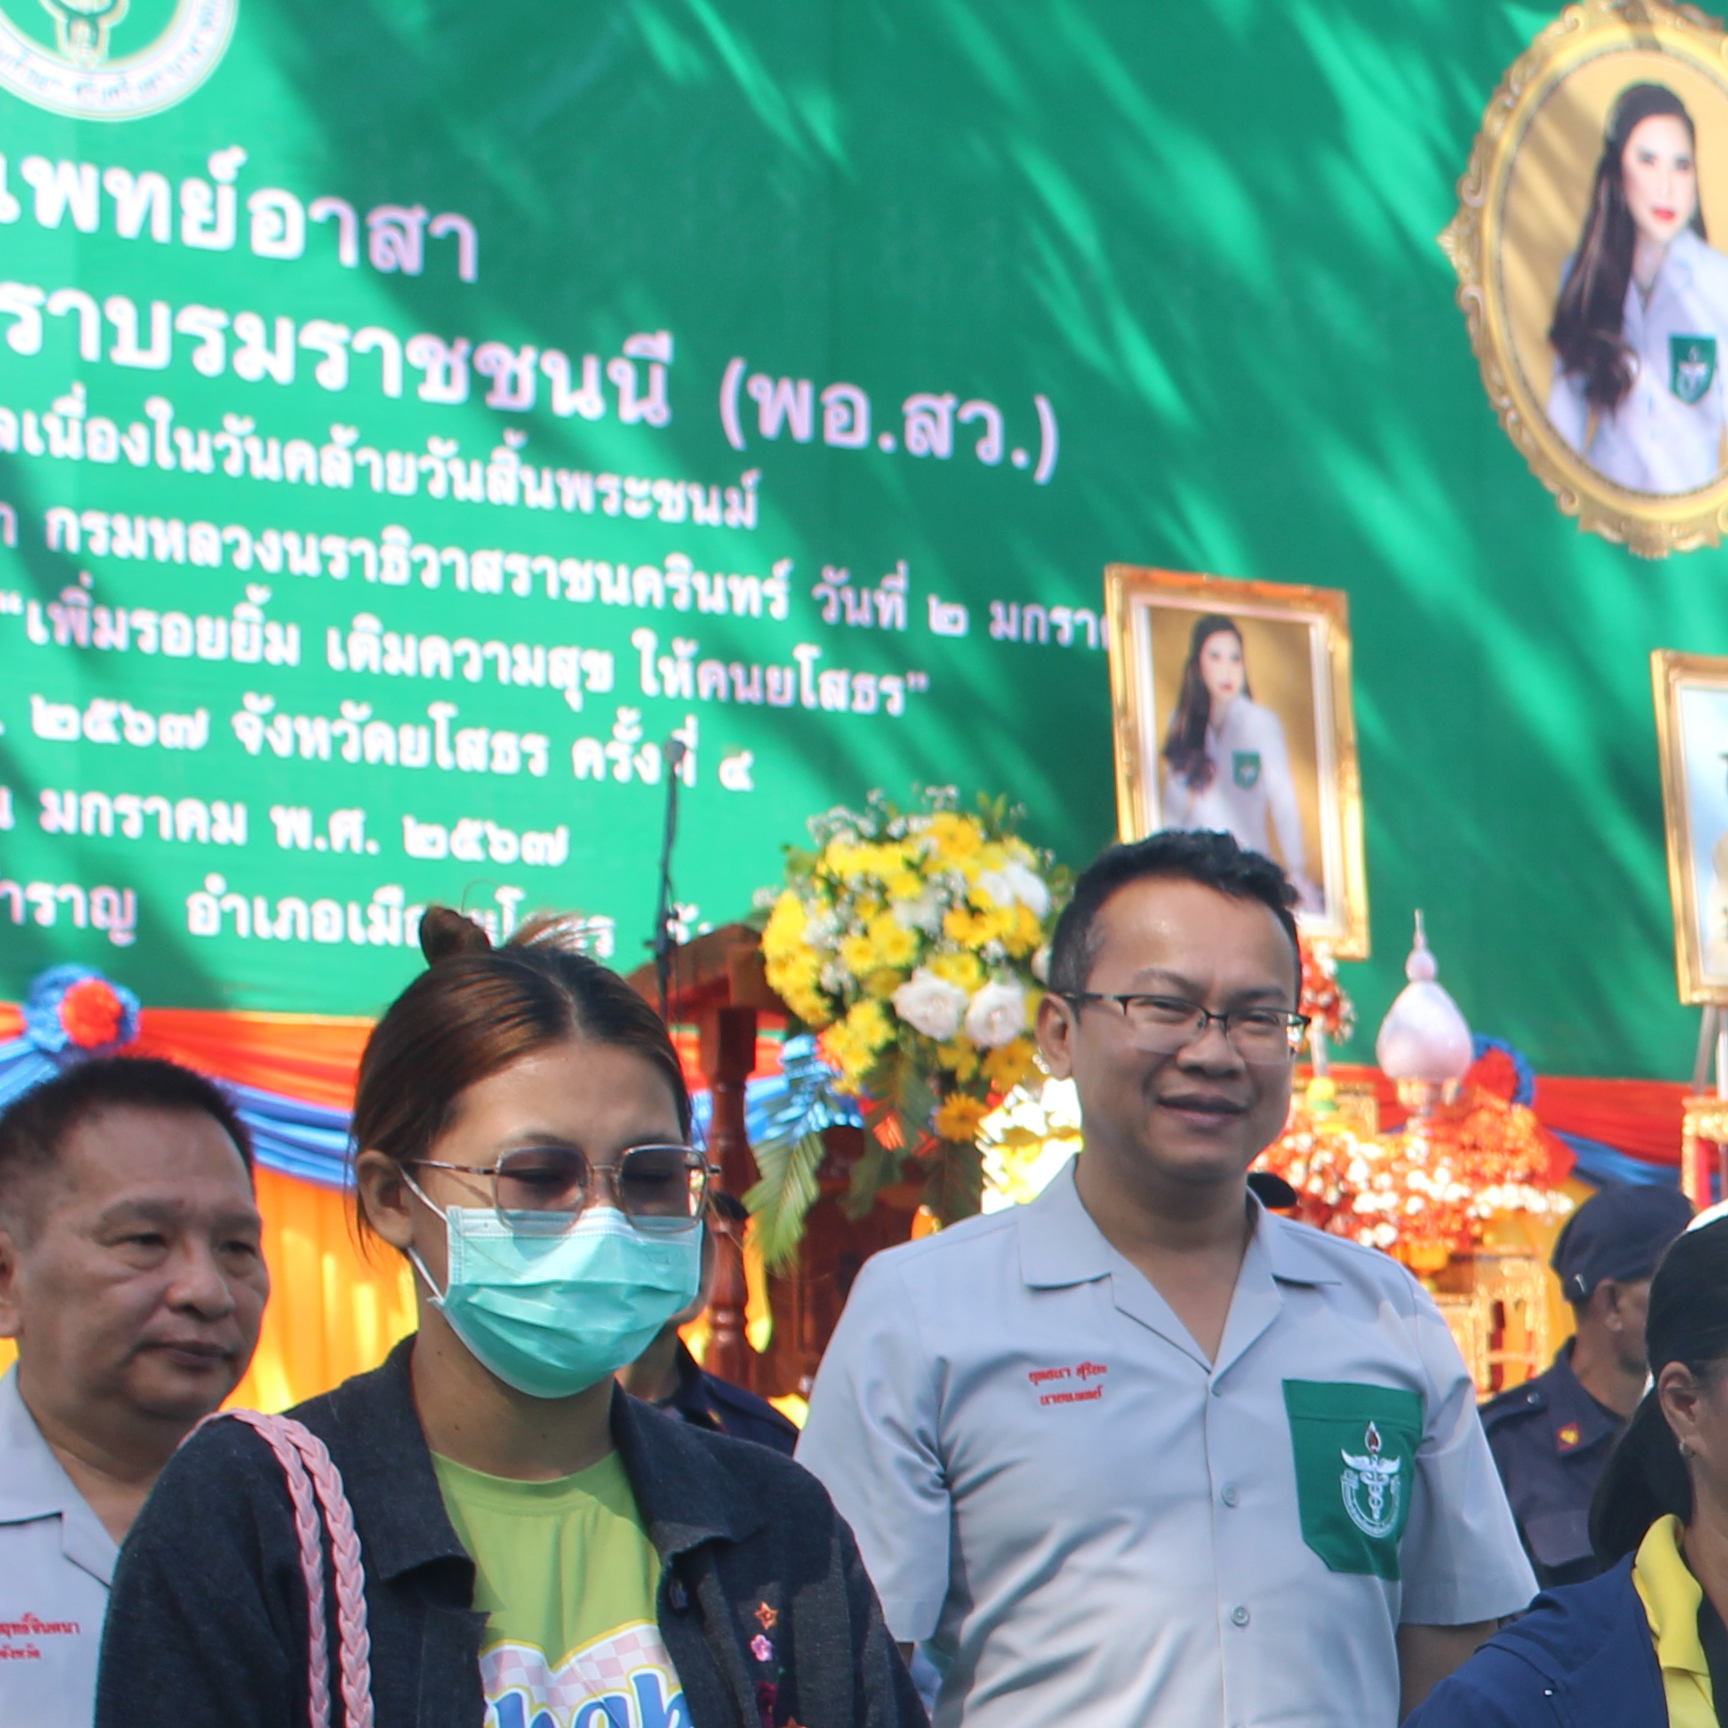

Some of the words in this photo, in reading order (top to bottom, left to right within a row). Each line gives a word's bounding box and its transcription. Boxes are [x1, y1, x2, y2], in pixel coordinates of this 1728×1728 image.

[719, 357, 1059, 484] (พอ.สว.)
[45, 506, 793, 622] กรมหลวงนราธิวาสราชนครินทร์
[812, 559, 909, 631] วันที่
[989, 600, 1114, 652] มกรา
[327, 613, 614, 712] เติมความสุข
[30, 693, 210, 751] ๒๕๖๗
[231, 691, 550, 777] จังหวัดยโสธร
[39, 788, 248, 847] มกราคม
[270, 804, 380, 855] พ.ศ.
[402, 815, 570, 867] ๒๕๖๗
